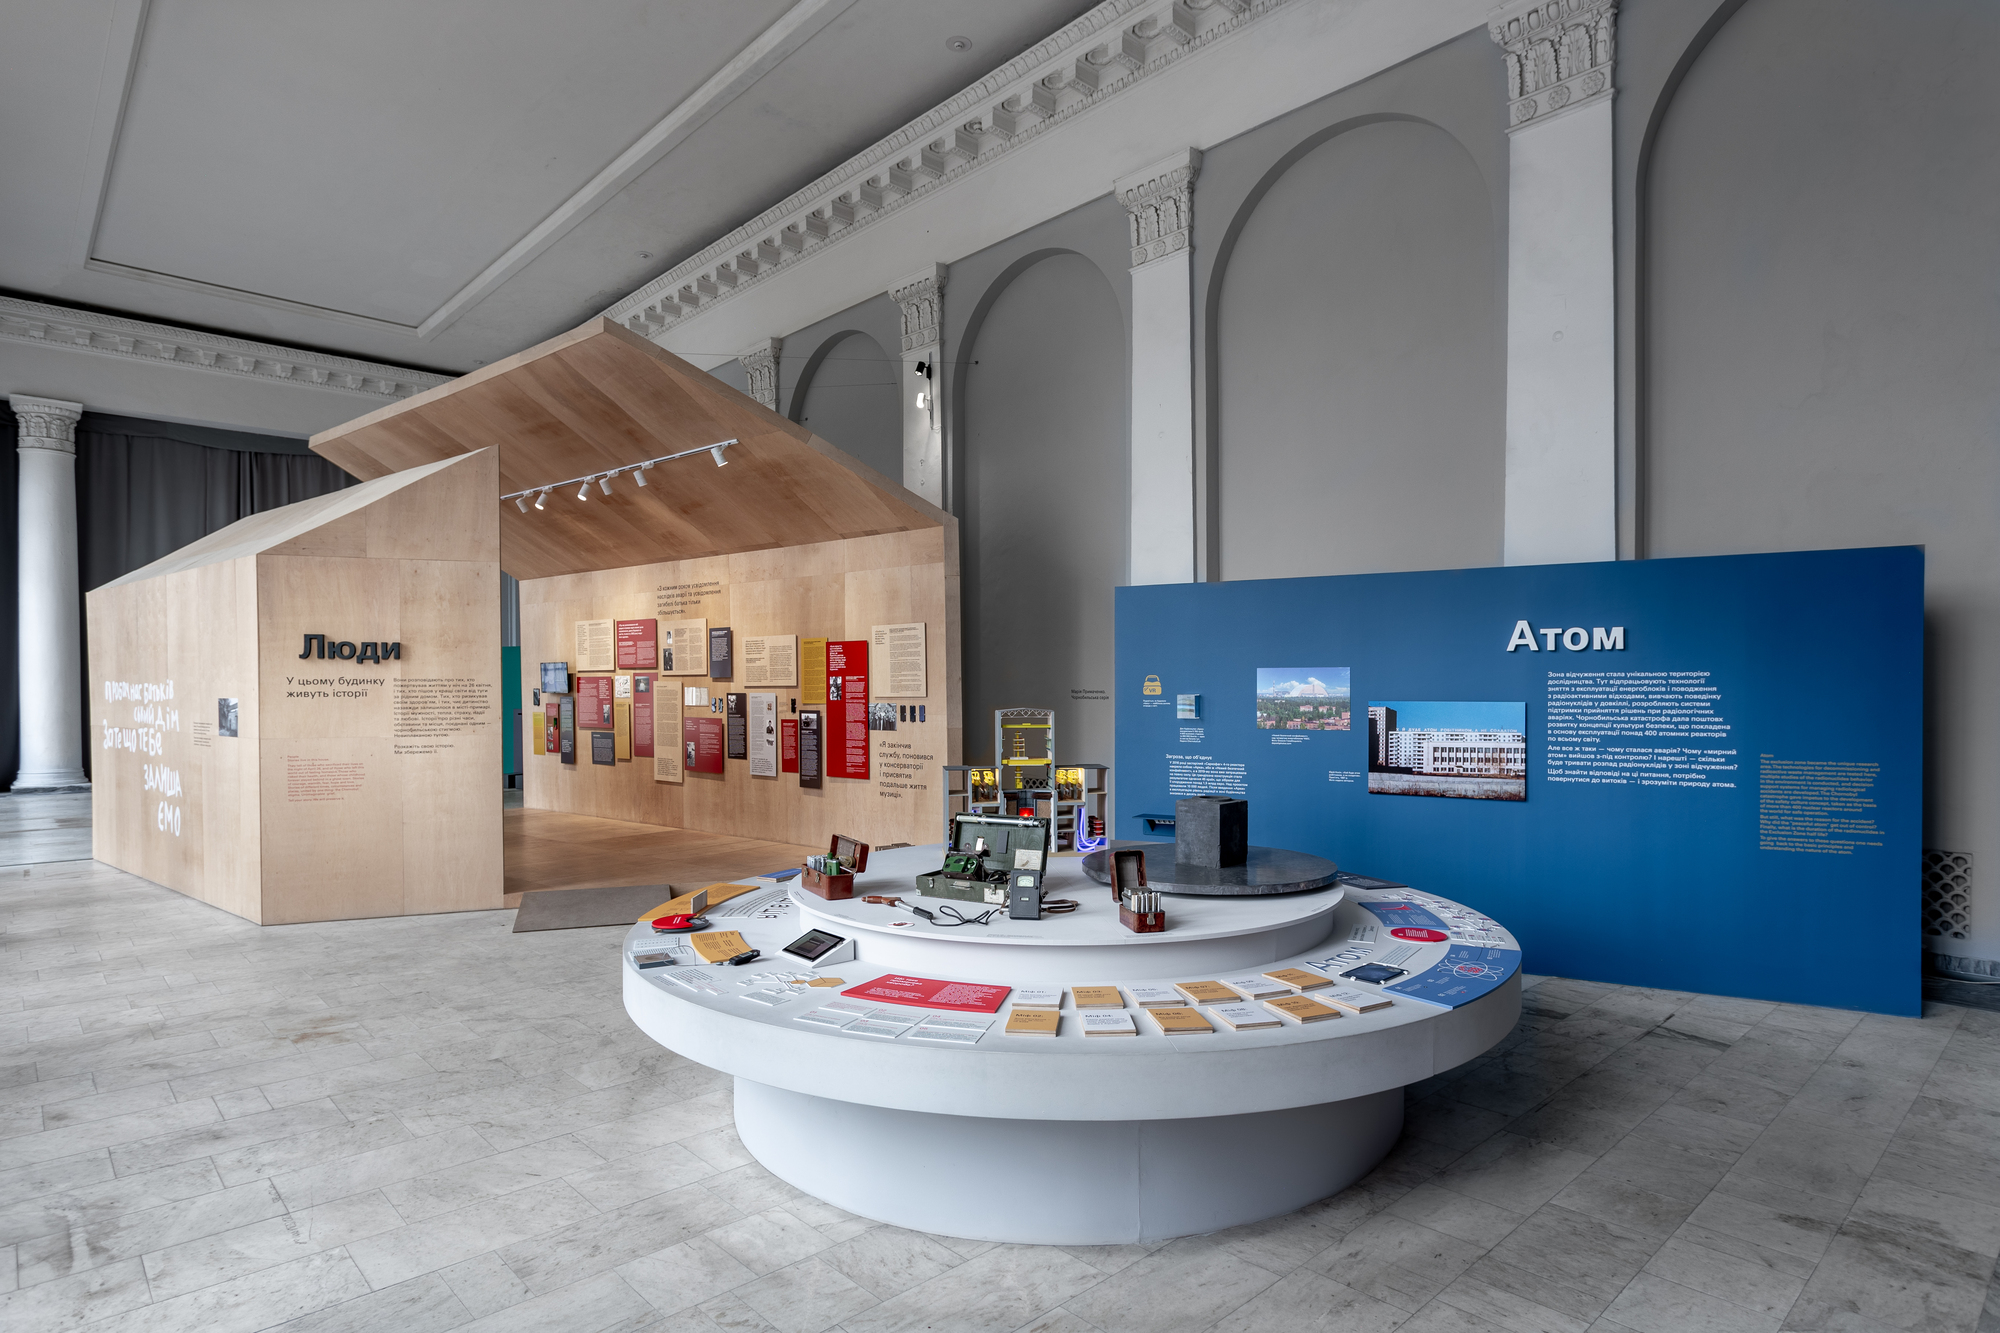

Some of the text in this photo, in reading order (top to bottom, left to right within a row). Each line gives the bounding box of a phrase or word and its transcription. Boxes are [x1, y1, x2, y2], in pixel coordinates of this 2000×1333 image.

[1506, 620, 1624, 651] Атом
[299, 634, 400, 664] Люди
[1669, 670, 1710, 678] територією
[298, 678, 335, 686] цьому
[338, 676, 385, 686] будинку
[1610, 677, 1666, 685] відпрацьовують
[286, 689, 368, 699] живуть історії
[1553, 692, 1607, 700] радіоактивними
[1548, 699, 1593, 707] радіонуклідів
[1600, 700, 1630, 708] довкіллі,
[1632, 700, 1679, 708] розробляють
[1548, 706, 1582, 714] підтримки
[1584, 707, 1619, 715] прийняття
[1621, 707, 1646, 715] рішень
[1662, 707, 1714, 716] радіологічних
[1548, 714, 1574, 722] аваріях.
[1576, 714, 1628, 722] Чорнобильська
[1630, 715, 1670, 723] катастрофа
[1579, 721, 1612, 730] концепції
[1645, 722, 1676, 730] безпеки,
[1578, 729, 1620, 737] експлуатації
[1691, 730, 1726, 738] реакторів
[1583, 736, 1600, 744] світу.
[879, 751, 901, 760] службу,
[1654, 747, 1681, 755] аварія?
[1682, 747, 1702, 756] Чому
[1704, 748, 1736, 756] «мирний
[1596, 753, 1613, 761] з-під
[1614, 753, 1652, 762] контролю?
[1658, 754, 1687, 762] нарешті
[1548, 759, 1563, 767] буде
[1619, 760, 1667, 769] радіонуклідів
[1691, 762, 1738, 771] відчуження?
[883, 772, 912, 780] присвятив
[1548, 768, 1563, 776] Щоб
[1589, 769, 1620, 778] відповіді
[1673, 771, 1706, 780] потрібно
[1548, 776, 1590, 784] повернутися
[1642, 778, 1677, 787] зрозуміти
[880, 790, 902, 800] музиці».
